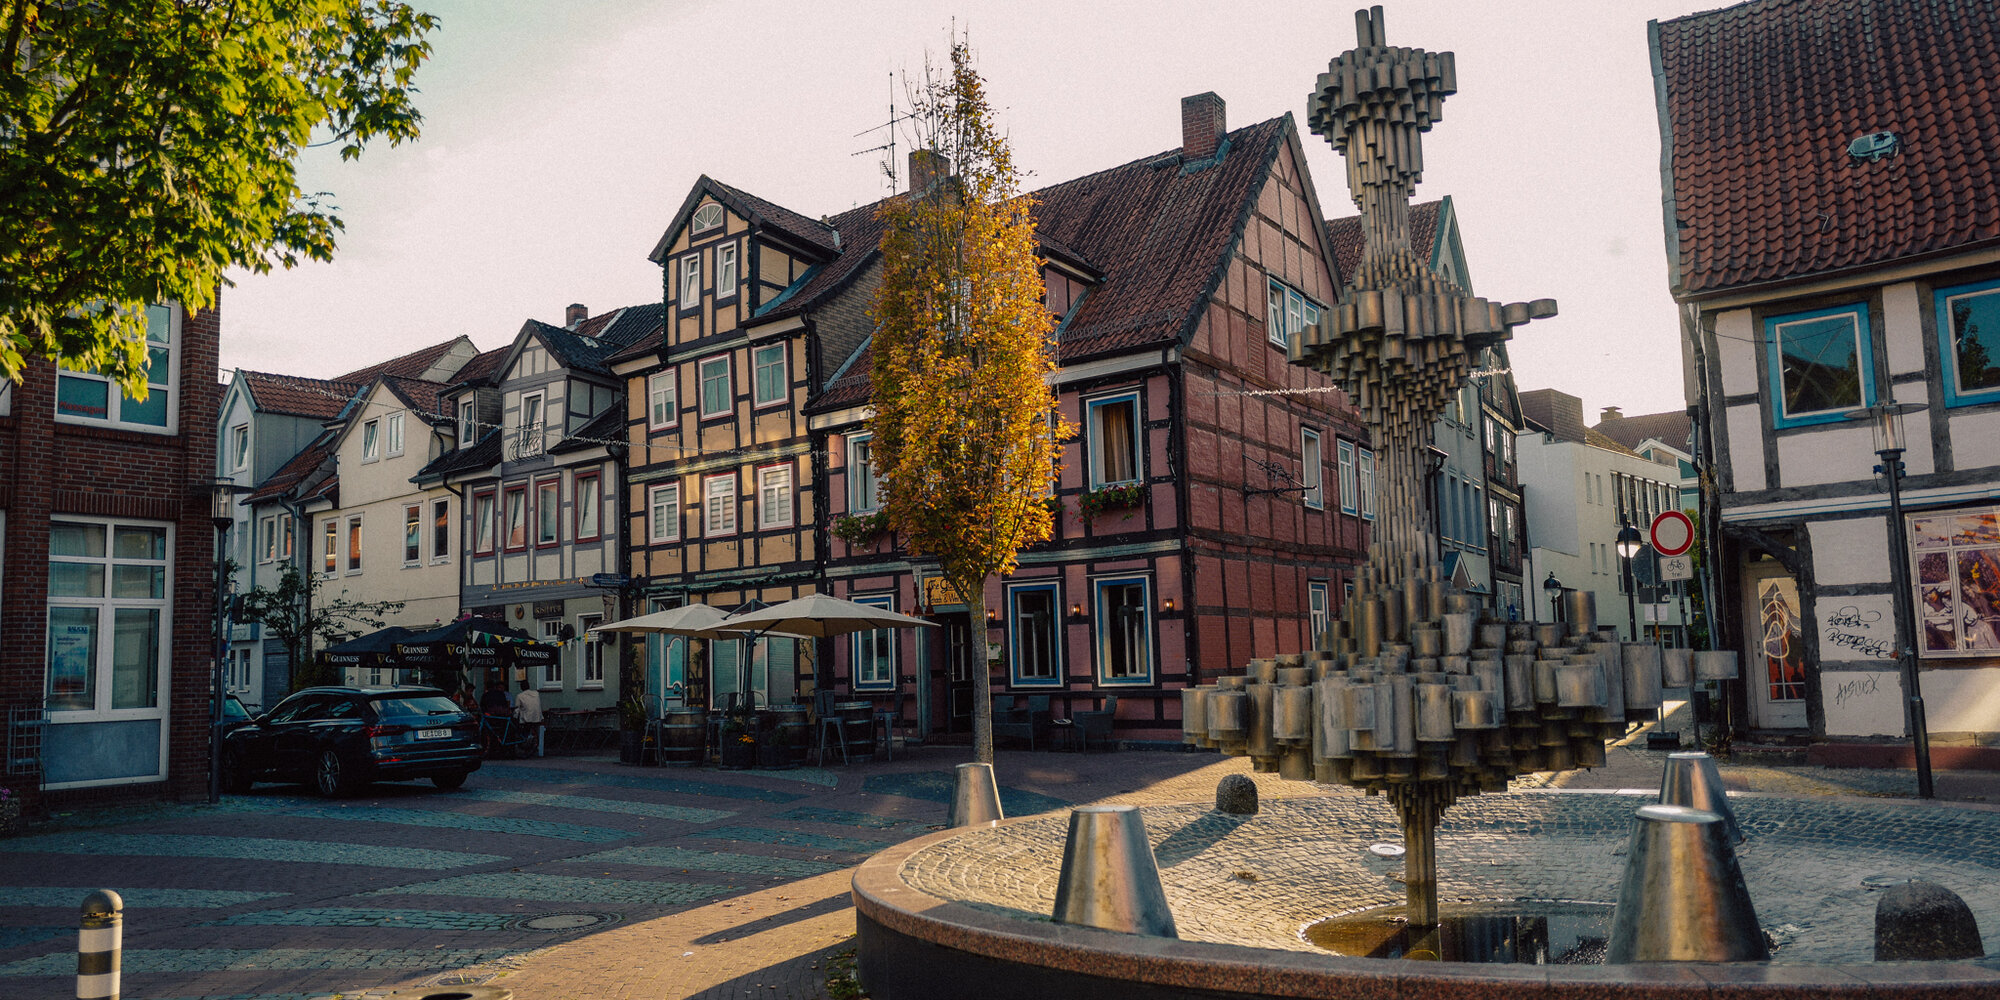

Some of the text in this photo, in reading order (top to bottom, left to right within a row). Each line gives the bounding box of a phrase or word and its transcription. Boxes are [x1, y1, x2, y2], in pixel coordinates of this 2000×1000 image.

[1671, 571, 1683, 579] frei
[402, 645, 430, 655] GUINNESS
[455, 645, 496, 656] GUNNESS
[520, 648, 550, 659] GUINNESS
[331, 654, 360, 664] GUINNESS
